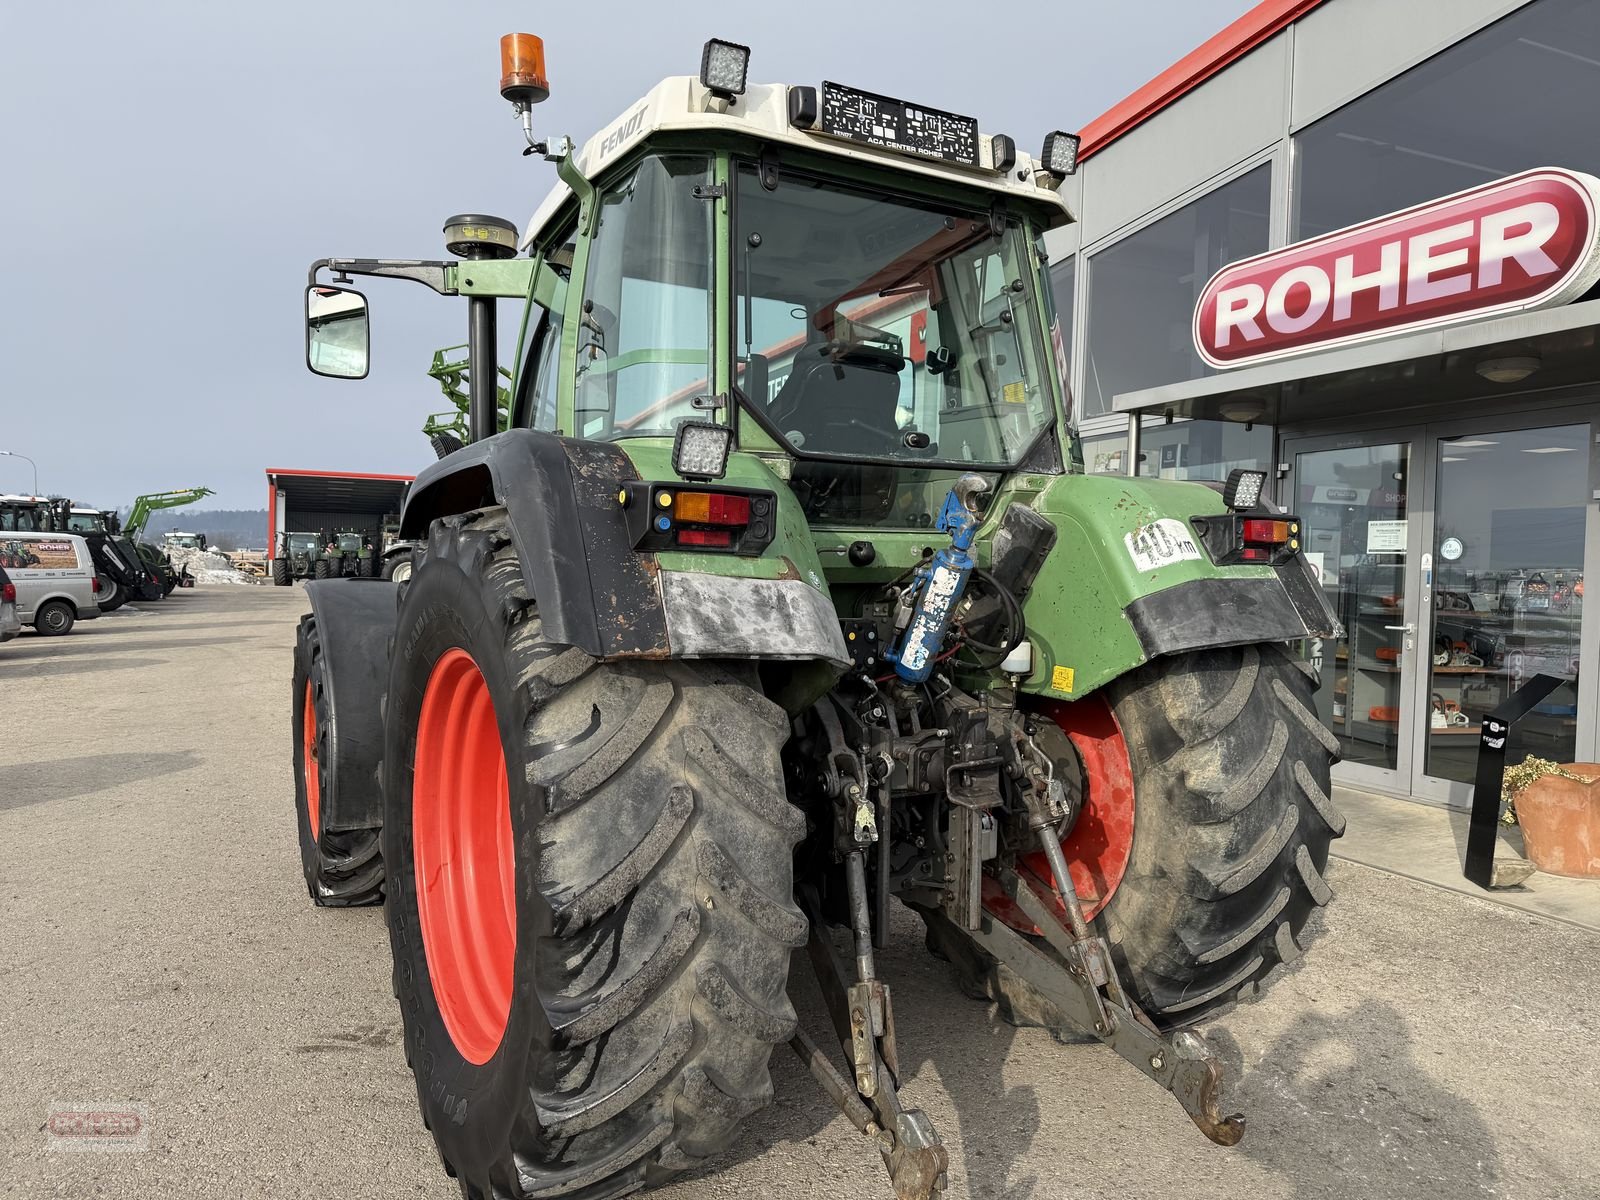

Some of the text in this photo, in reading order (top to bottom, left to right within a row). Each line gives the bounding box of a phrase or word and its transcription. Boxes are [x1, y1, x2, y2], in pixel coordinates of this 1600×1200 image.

[600, 104, 649, 159] FENDT
[833, 129, 853, 138] FENDT
[867, 137, 943, 158] ACA CENTER ROHER
[956, 156, 973, 164] FENDT
[1214, 201, 1561, 349] ROHER
[1131, 523, 1197, 564] 40 km
